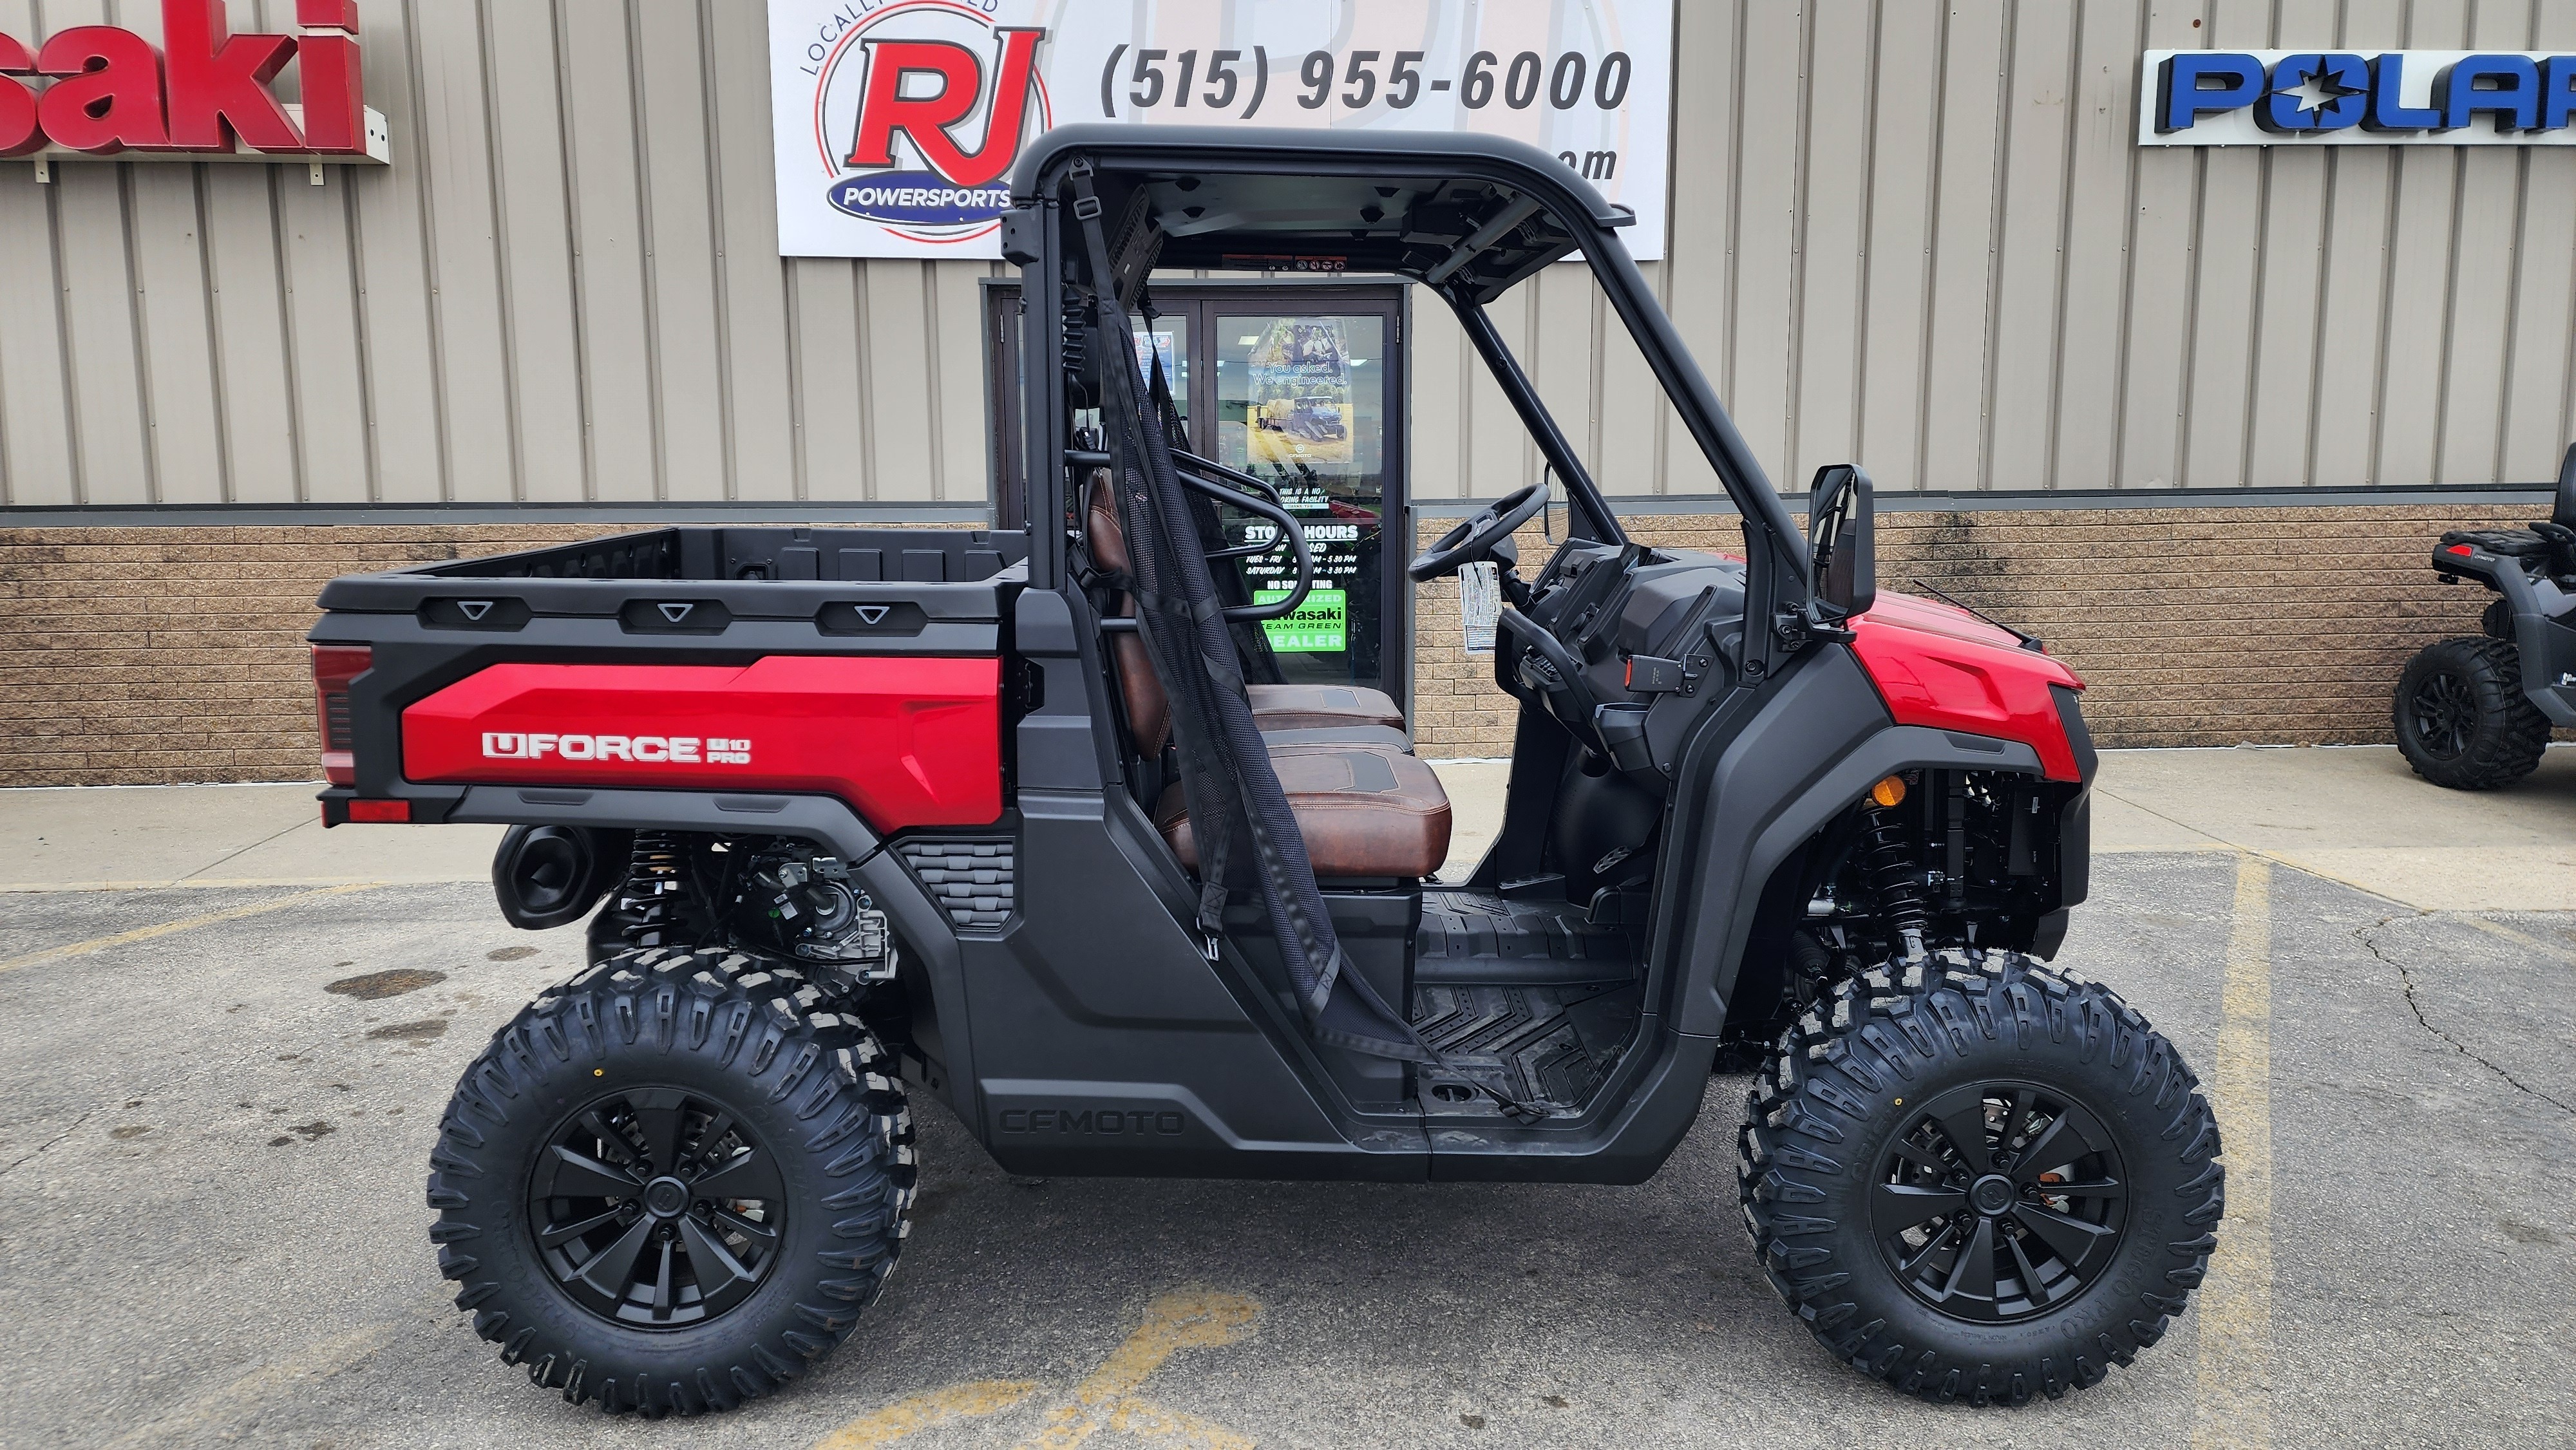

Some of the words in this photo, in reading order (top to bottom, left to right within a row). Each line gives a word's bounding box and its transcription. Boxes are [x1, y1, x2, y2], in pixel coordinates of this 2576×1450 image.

[1101, 43, 1268, 119] (515)
[1296, 50, 1631, 110] 955-6000
[842, 26, 1046, 187] RJ
[844, 187, 1010, 207] POWERSPORTS
[1269, 361, 1291, 373] You
[1293, 361, 1333, 373] asked.
[1253, 373, 1273, 385] We
[1275, 373, 1347, 388] engineered.
[1303, 525, 1358, 539] HOURS
[1245, 555, 1264, 563] TUES
[1269, 555, 1283, 563] FRI
[1343, 554, 1357, 563] PM
[1245, 566, 1285, 574] SATURDAY
[1343, 566, 1357, 574] PM
[1267, 580, 1280, 590] NO
[1282, 580, 1332, 590] SOTING
[1258, 594, 1342, 603] AUTRIZED
[1271, 607, 1341, 621] wasaki
[1271, 634, 1342, 648] EALER
[482, 732, 701, 764] UFORCE
[706, 737, 752, 752] U10
[706, 751, 752, 765] PRO
[999, 1109, 1185, 1136] CFMOTO
